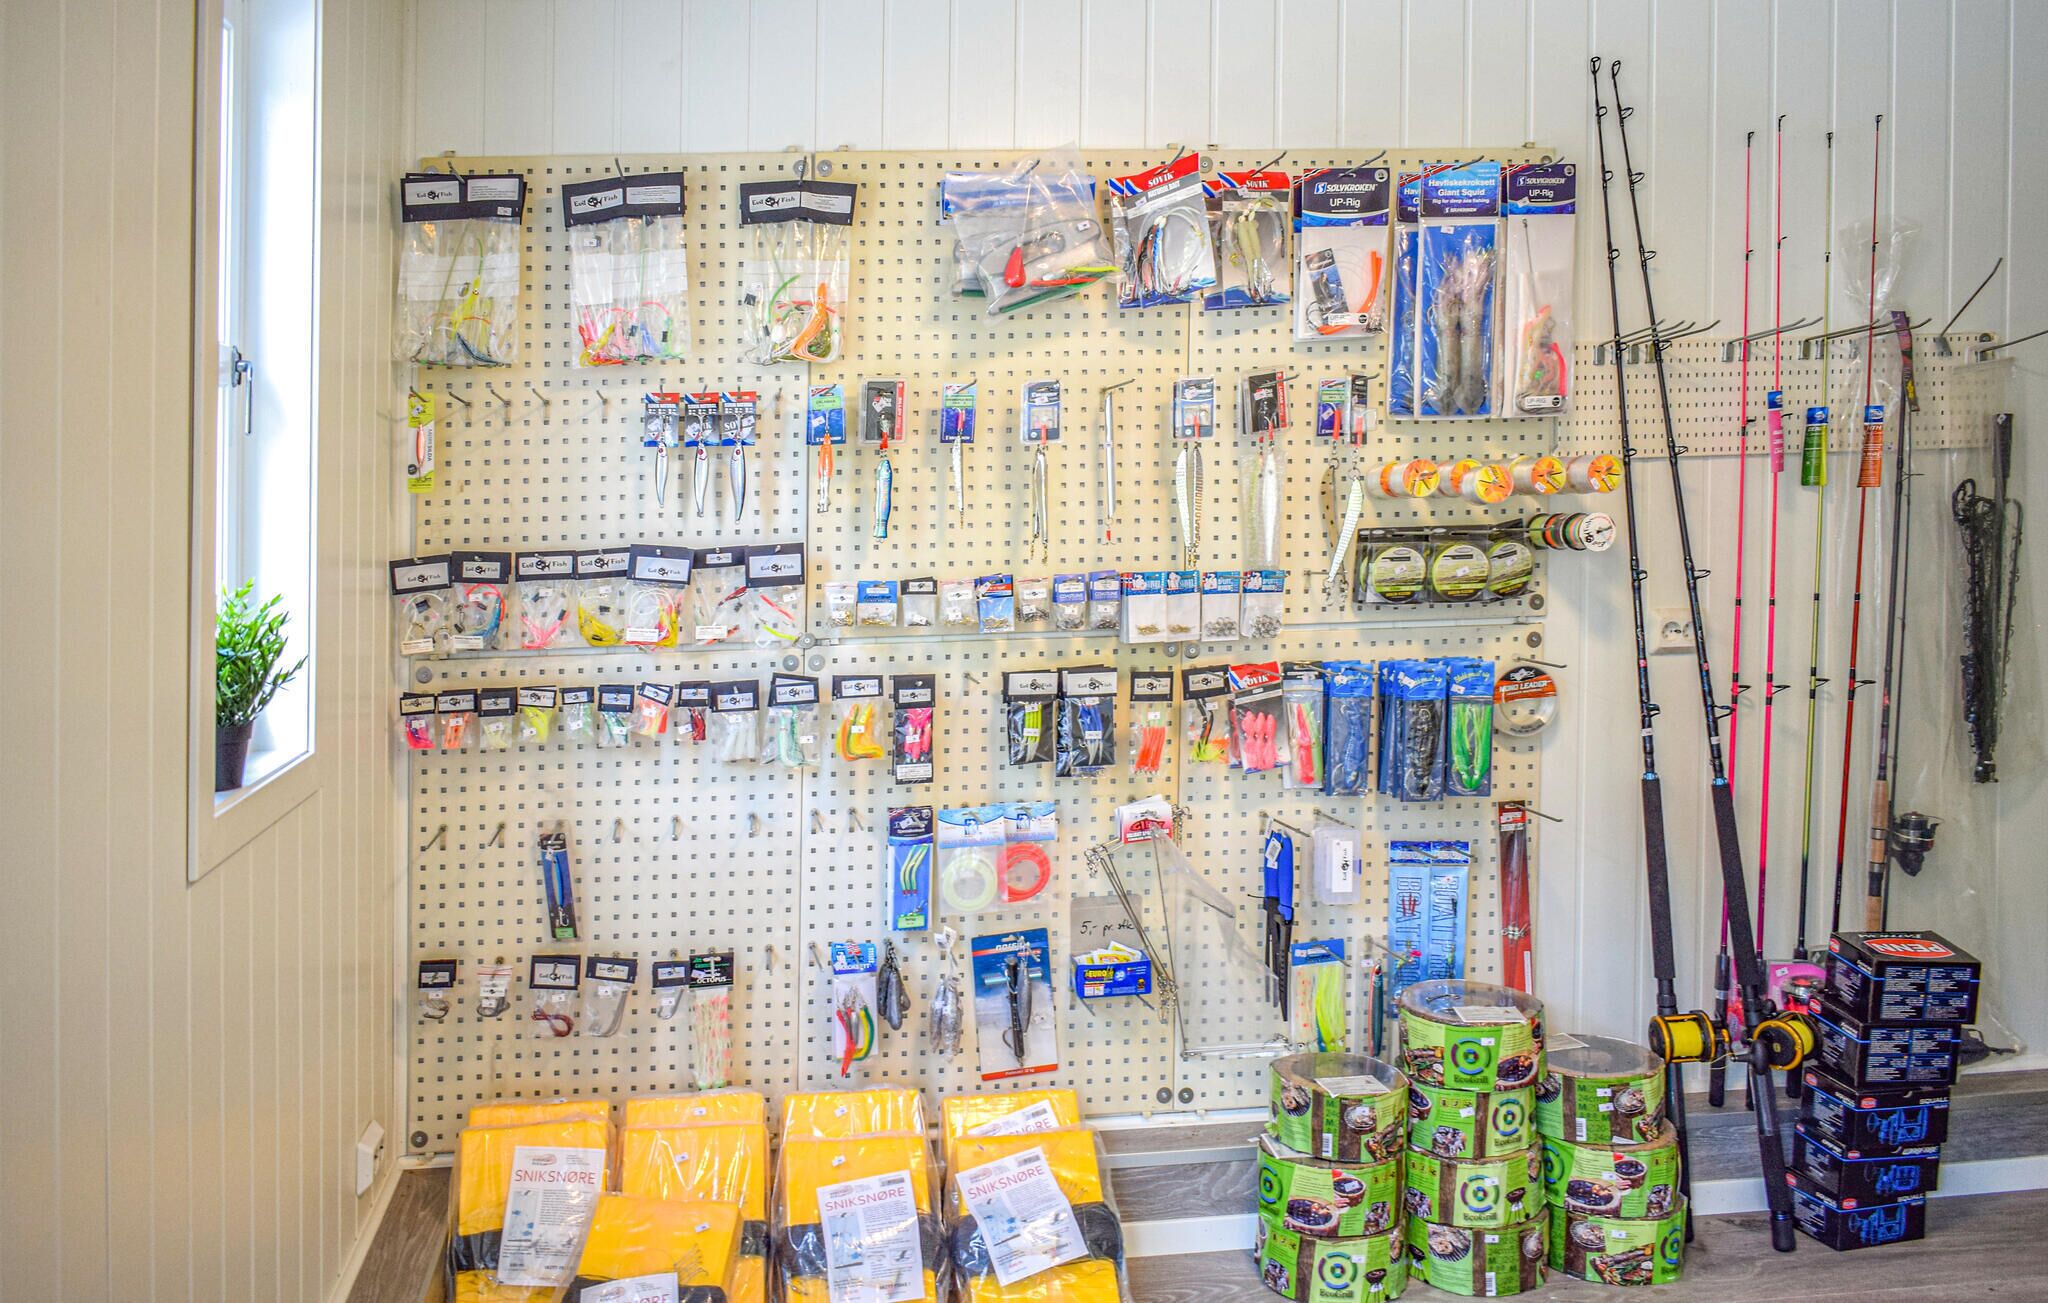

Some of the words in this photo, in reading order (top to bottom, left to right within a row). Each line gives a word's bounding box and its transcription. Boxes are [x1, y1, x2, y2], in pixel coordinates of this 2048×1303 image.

[1428, 179, 1495, 187] Havfiskekroksett
[1438, 188, 1459, 196] Giant
[1462, 188, 1486, 198] Squid
[1529, 189, 1554, 198] UP-Rig
[573, 199, 587, 208] Evil
[603, 194, 619, 203] Fish
[780, 196, 796, 204] Fish
[1329, 197, 1361, 208] UP-Rig
[1520, 680, 1547, 690] LEADER
[1871, 943, 1944, 953] PENN
[697, 976, 727, 984] OCTOPUS
[1454, 1074, 1489, 1084] EcoGrill
[1494, 1135, 1521, 1147] EcoGrill
[515, 1169, 596, 1185] SNIKSNØRE
[968, 1165, 1045, 1200] SNIKSNØRE
[825, 1187, 907, 1212] SNIKSNØRE
[1464, 1212, 1497, 1221] EcoGrill
[1319, 1288, 1353, 1298] EcoGrill
